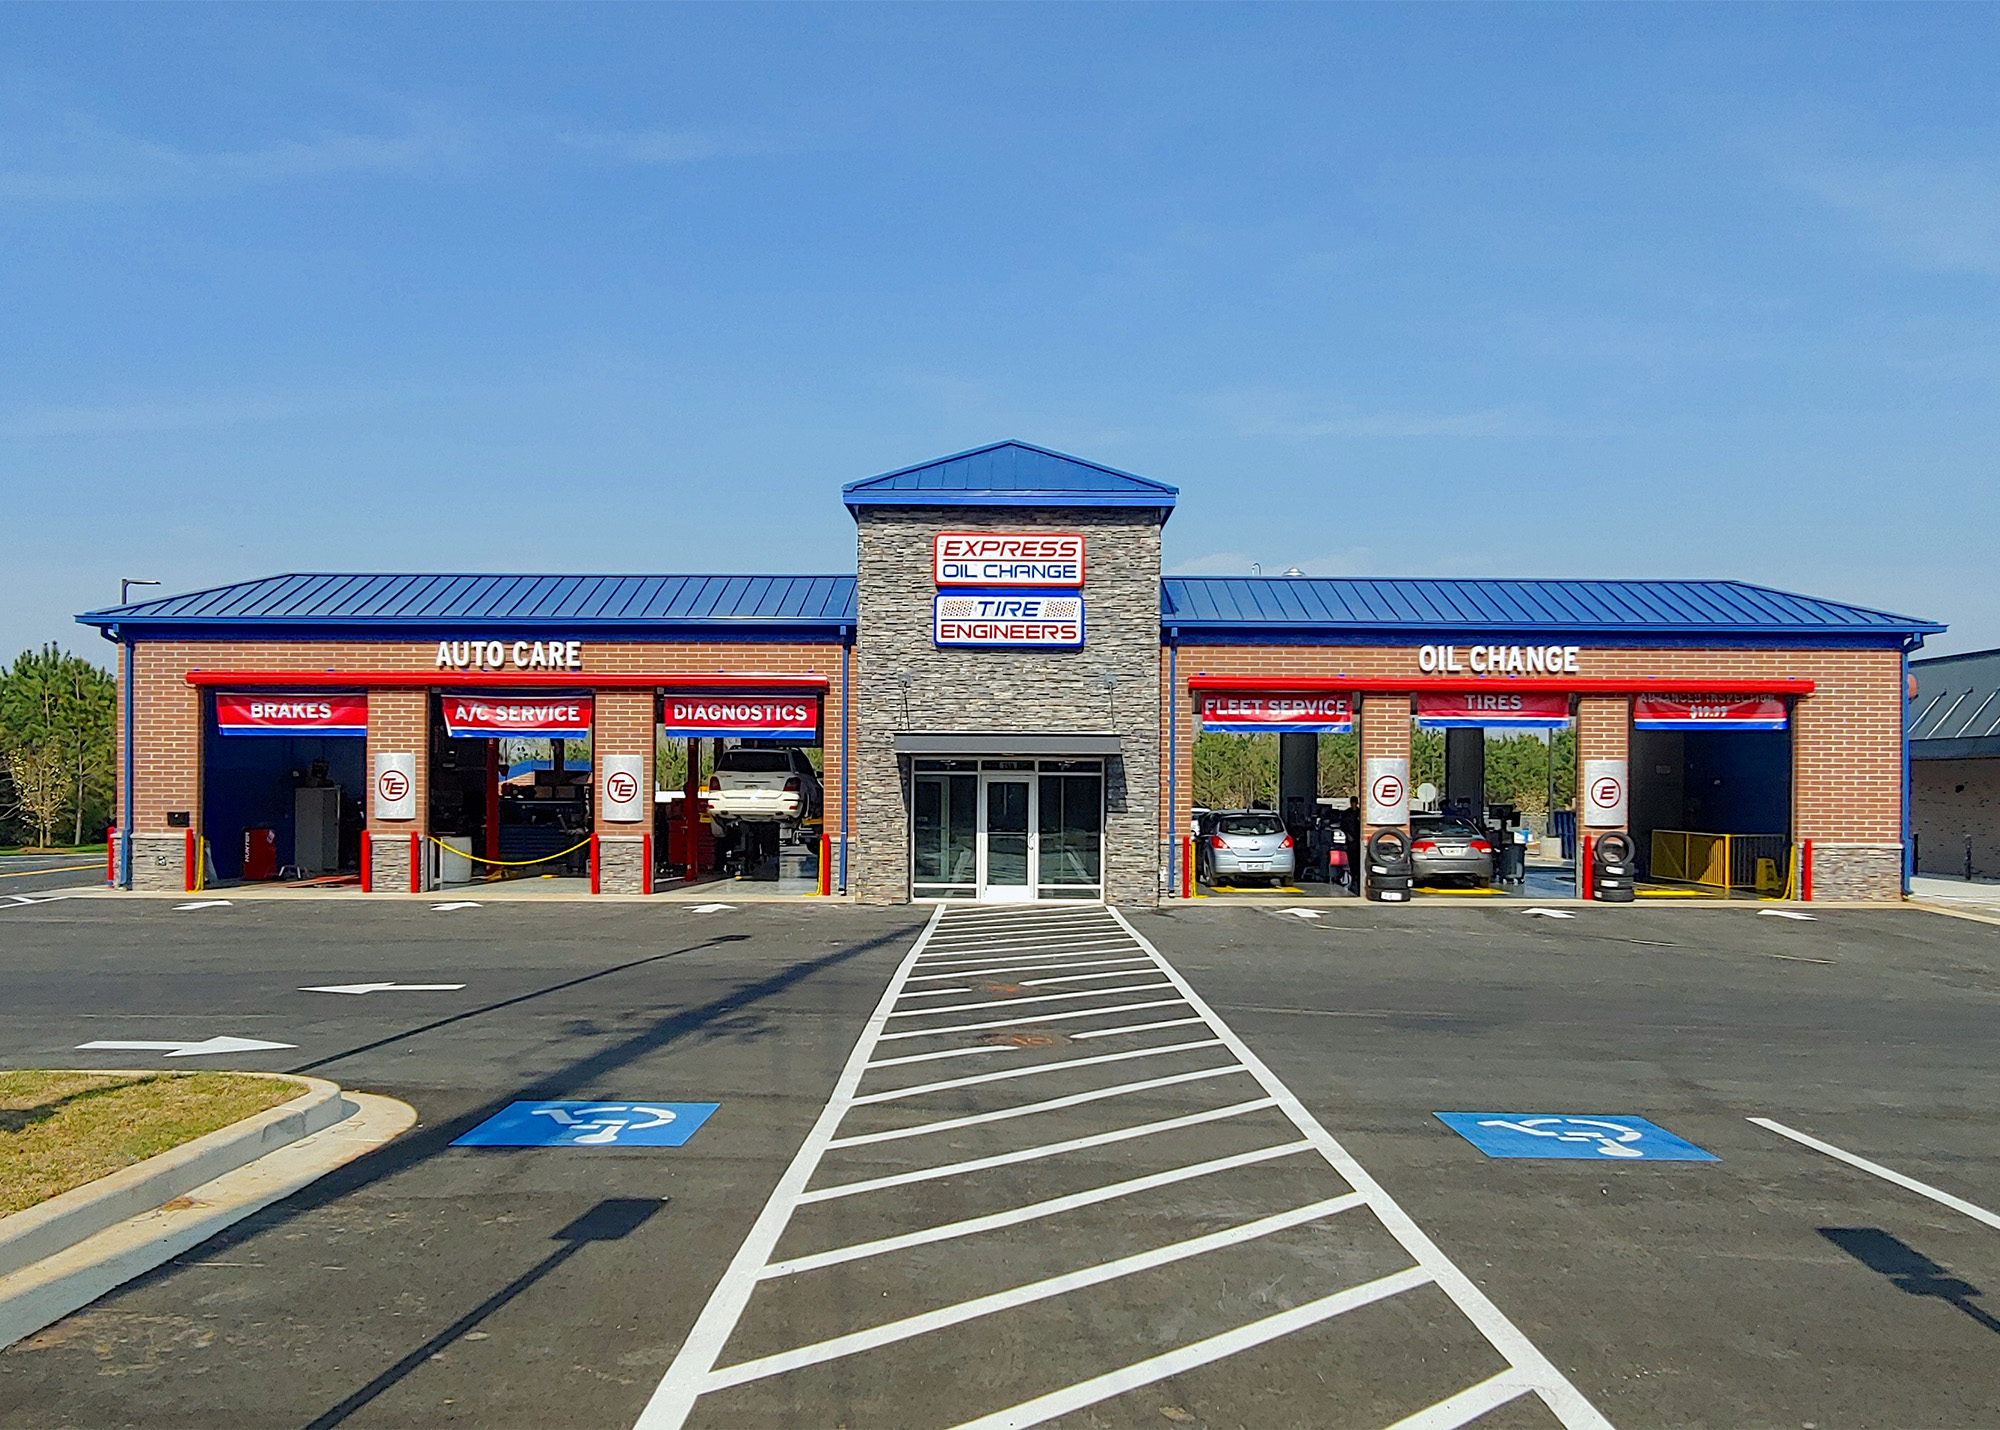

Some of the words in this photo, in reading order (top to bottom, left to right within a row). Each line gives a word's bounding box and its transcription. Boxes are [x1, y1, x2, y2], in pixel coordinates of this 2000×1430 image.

[943, 540, 1078, 557] EXPRESS
[943, 564, 977, 578] OIL
[983, 564, 1077, 579] CHANGE
[977, 601, 1041, 617] TIRE
[941, 624, 1077, 640] ENGINEERS
[435, 640, 505, 667] AUTO
[512, 640, 582, 667] CARE
[1418, 645, 1463, 672] OIL
[1469, 645, 1581, 672] CHANGE
[250, 702, 332, 719] BRAKES
[1204, 699, 1263, 715] FLEET
[1268, 699, 1348, 716] SERVICE
[1464, 694, 1523, 710] TIRES
[455, 703, 490, 722] A/C
[495, 705, 581, 722] SERVICE
[673, 704, 807, 721] DIAGNOSTICS
[1689, 704, 1728, 719] $19.99
